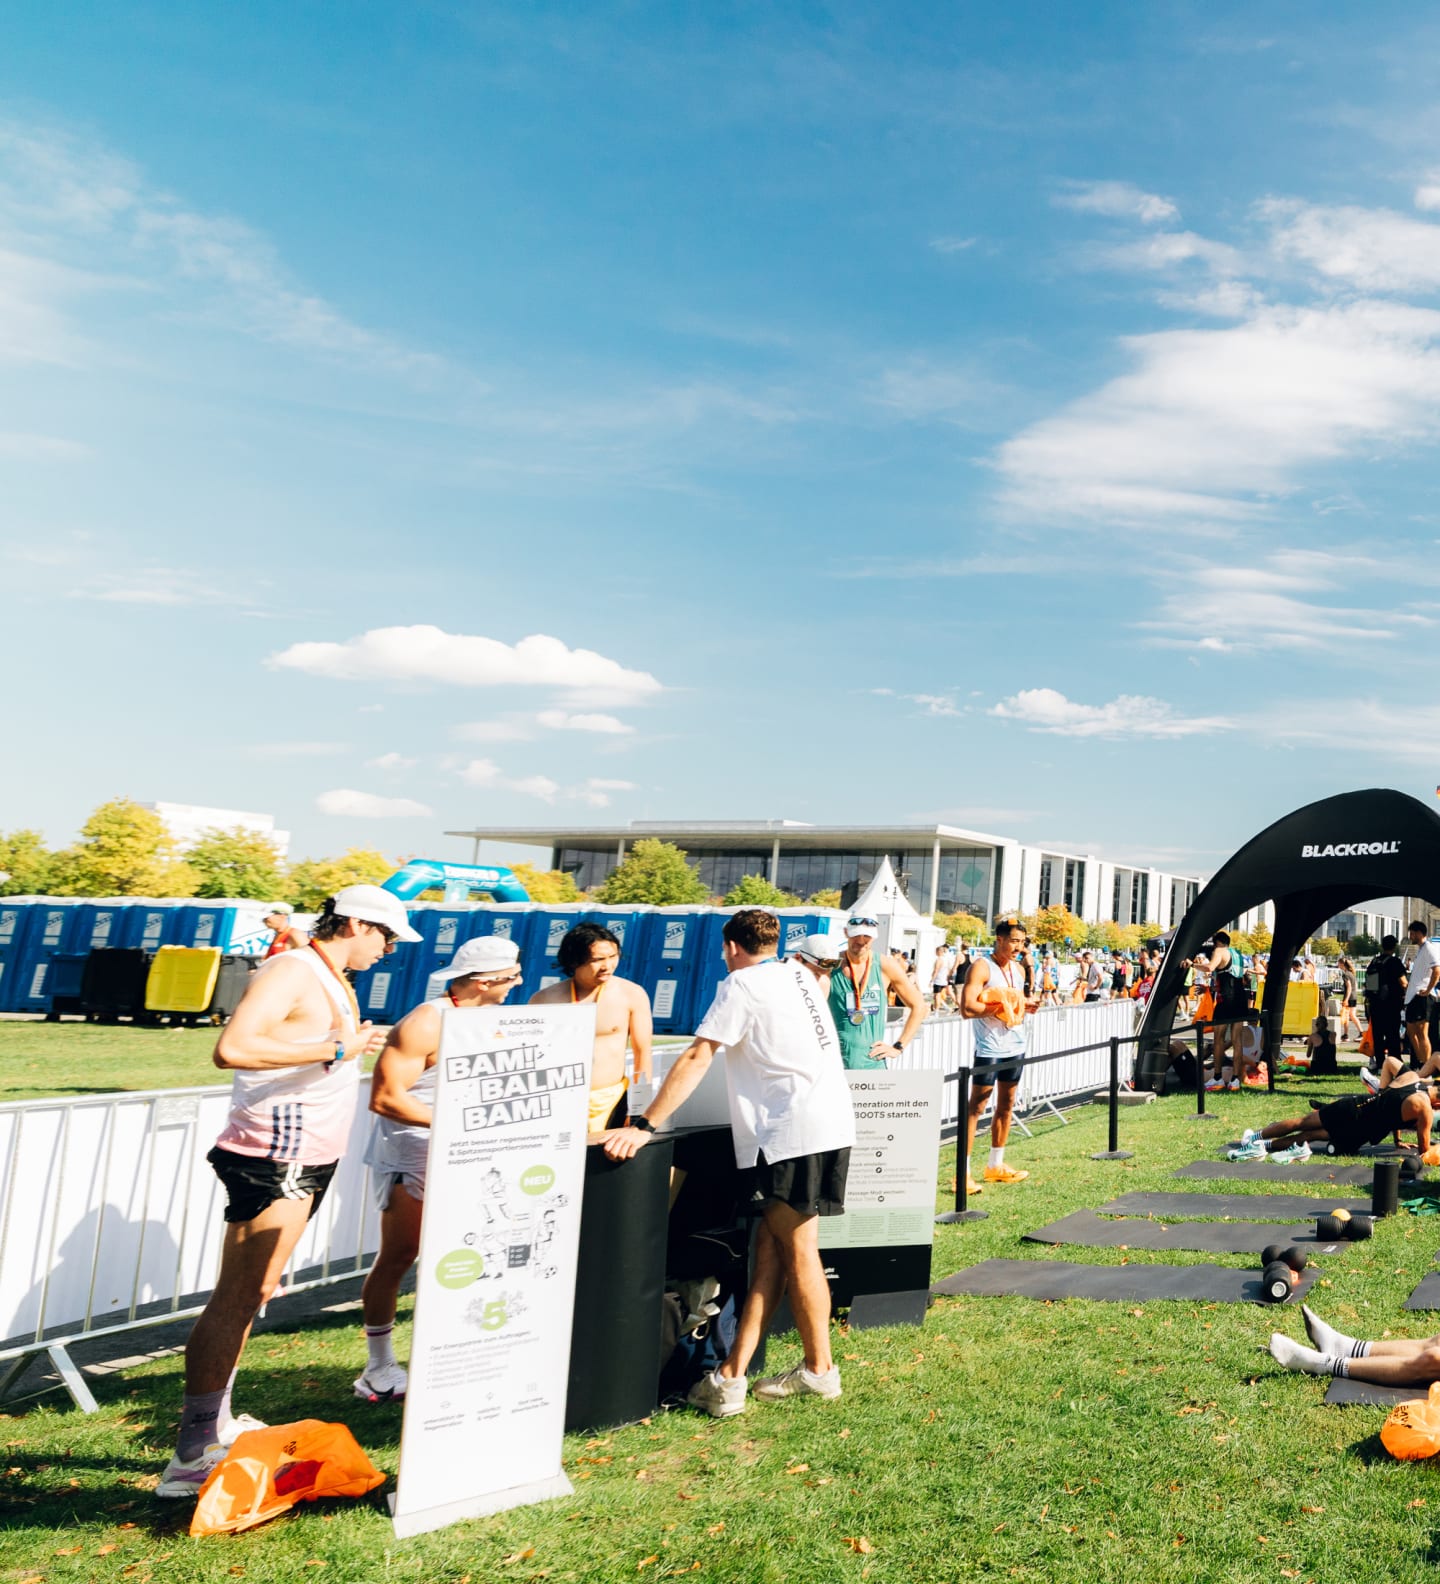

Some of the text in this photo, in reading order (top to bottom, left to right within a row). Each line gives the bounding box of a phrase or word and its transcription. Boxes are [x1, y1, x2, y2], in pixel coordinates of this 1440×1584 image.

[1301, 841, 1399, 858] BLACKROLL
[448, 1047, 534, 1080] BAM!
[481, 1064, 584, 1101] BALM!
[465, 1096, 551, 1131] BAM!
[887, 1111, 922, 1119] starten.
[896, 1100, 910, 1108] mit
[912, 1100, 929, 1108] den
[524, 1175, 551, 1186] NEU
[482, 1300, 508, 1331] 5
